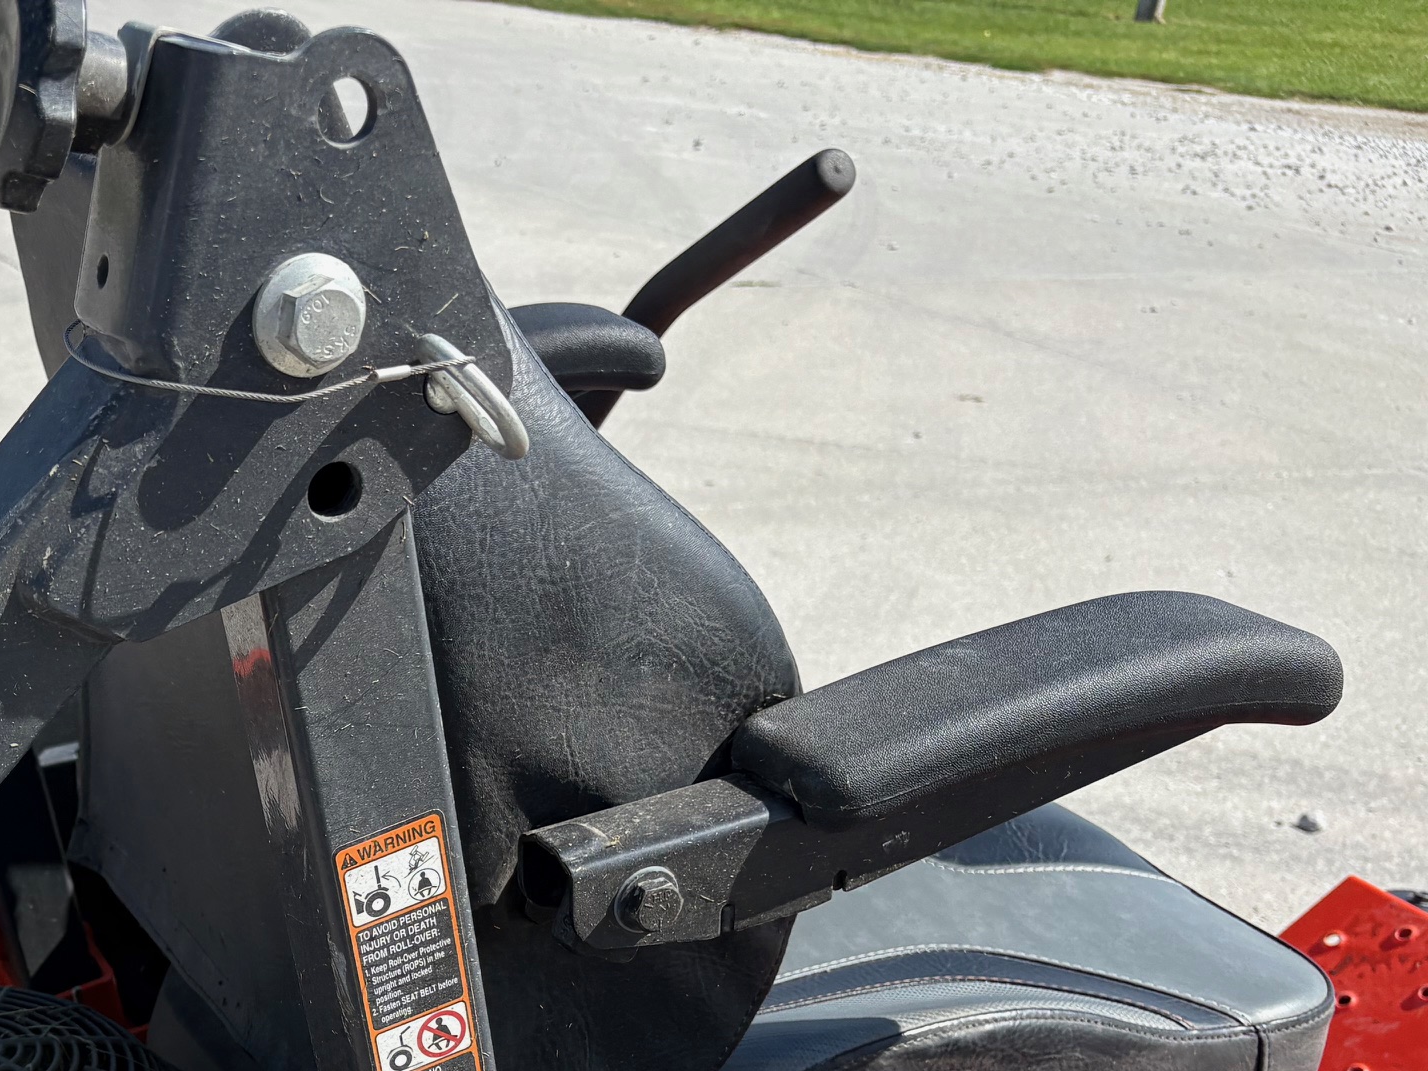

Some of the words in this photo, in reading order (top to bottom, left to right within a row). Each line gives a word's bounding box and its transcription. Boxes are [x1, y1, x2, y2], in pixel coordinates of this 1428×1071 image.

[357, 820, 437, 861] WARNING
[358, 930, 370, 942] TO
[372, 921, 398, 938] AVOID
[399, 901, 447, 926] PERSONAL
[360, 934, 392, 954] INJURY
[393, 928, 407, 941] OR
[408, 916, 437, 936] DEATH
[362, 949, 388, 966] FROM
[389, 928, 441, 954] ROLL-OVER:
[370, 963, 387, 975] Keep
[388, 950, 419, 968] Roll-Over
[419, 937, 451, 955] Protective
[371, 968, 402, 986] Structure
[402, 957, 427, 975] (ROPS)
[427, 954, 434, 963] in
[434, 950, 445, 960] the
[373, 979, 398, 995] upright
[398, 974, 411, 983] and
[411, 965, 433, 980] locked
[372, 1008, 378, 1017] 2.
[379, 999, 401, 1014] Fasten
[401, 991, 419, 1005] SEAT
[419, 984, 437, 998] BELT
[437, 976, 458, 990] before
[375, 989, 404, 1006] position.
